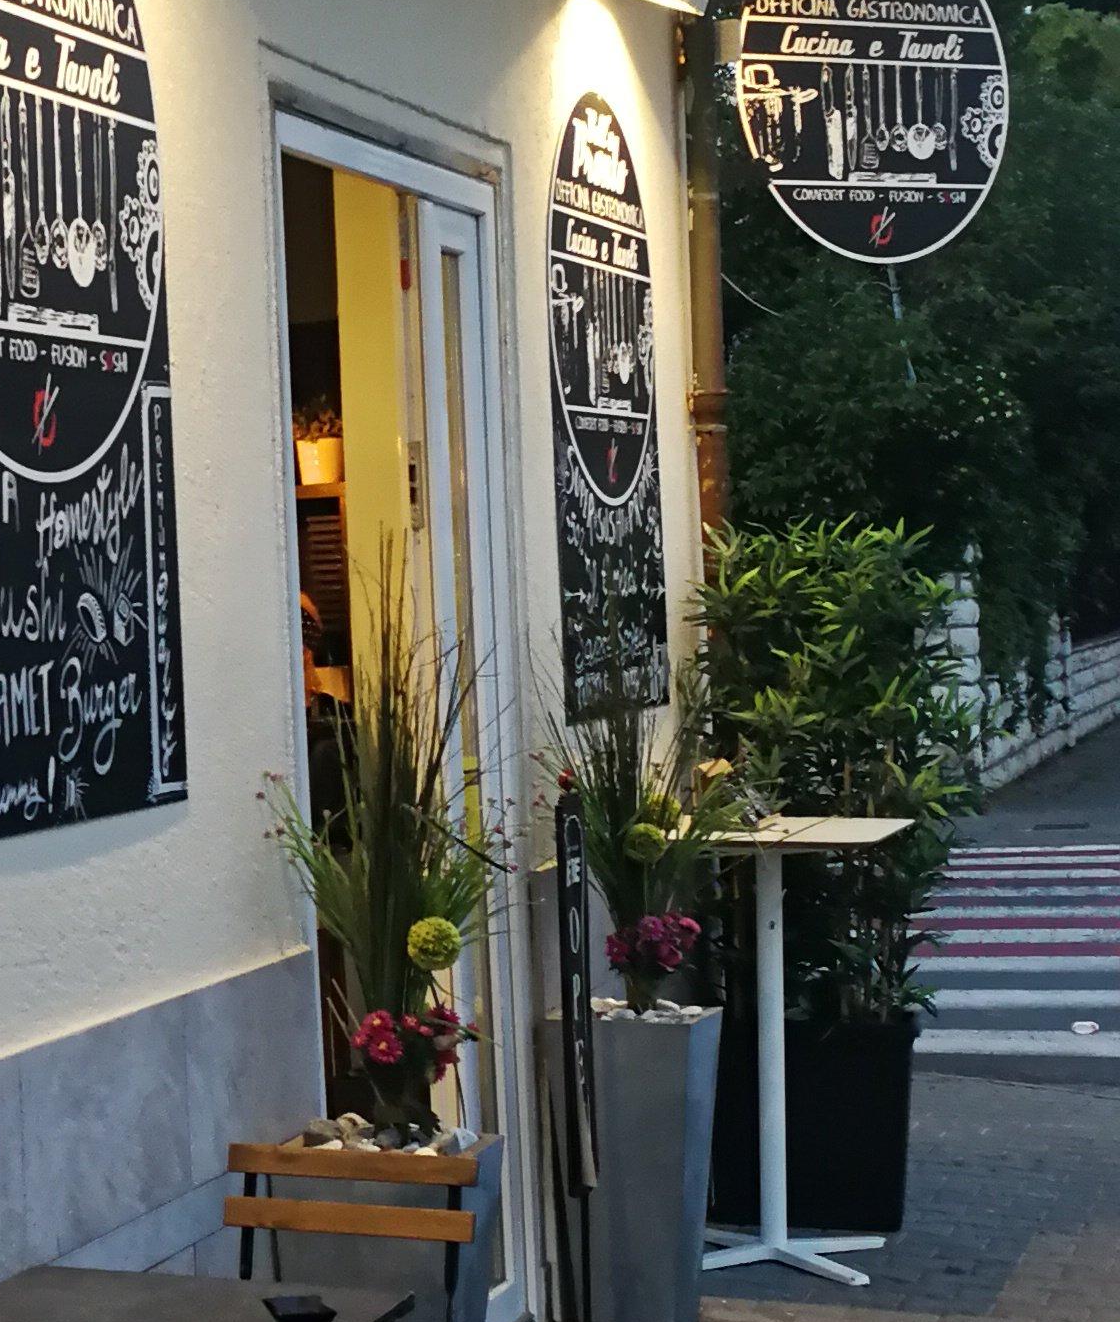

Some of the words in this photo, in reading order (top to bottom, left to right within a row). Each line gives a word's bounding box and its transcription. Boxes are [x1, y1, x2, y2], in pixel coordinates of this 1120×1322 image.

[780, 25, 856, 56] Cucina
[869, 40, 885, 58] e
[897, 30, 964, 61] Tavoli
[25, 47, 42, 80] e
[54, 34, 121, 106] Tavoli
[792, 187, 846, 202] COMFORT
[849, 189, 876, 203] FOOD
[888, 189, 924, 203] FUSION
[9, 337, 38, 362] FOOD
[51, 343, 88, 369] FUSION
[59, 656, 143, 775] Burger
